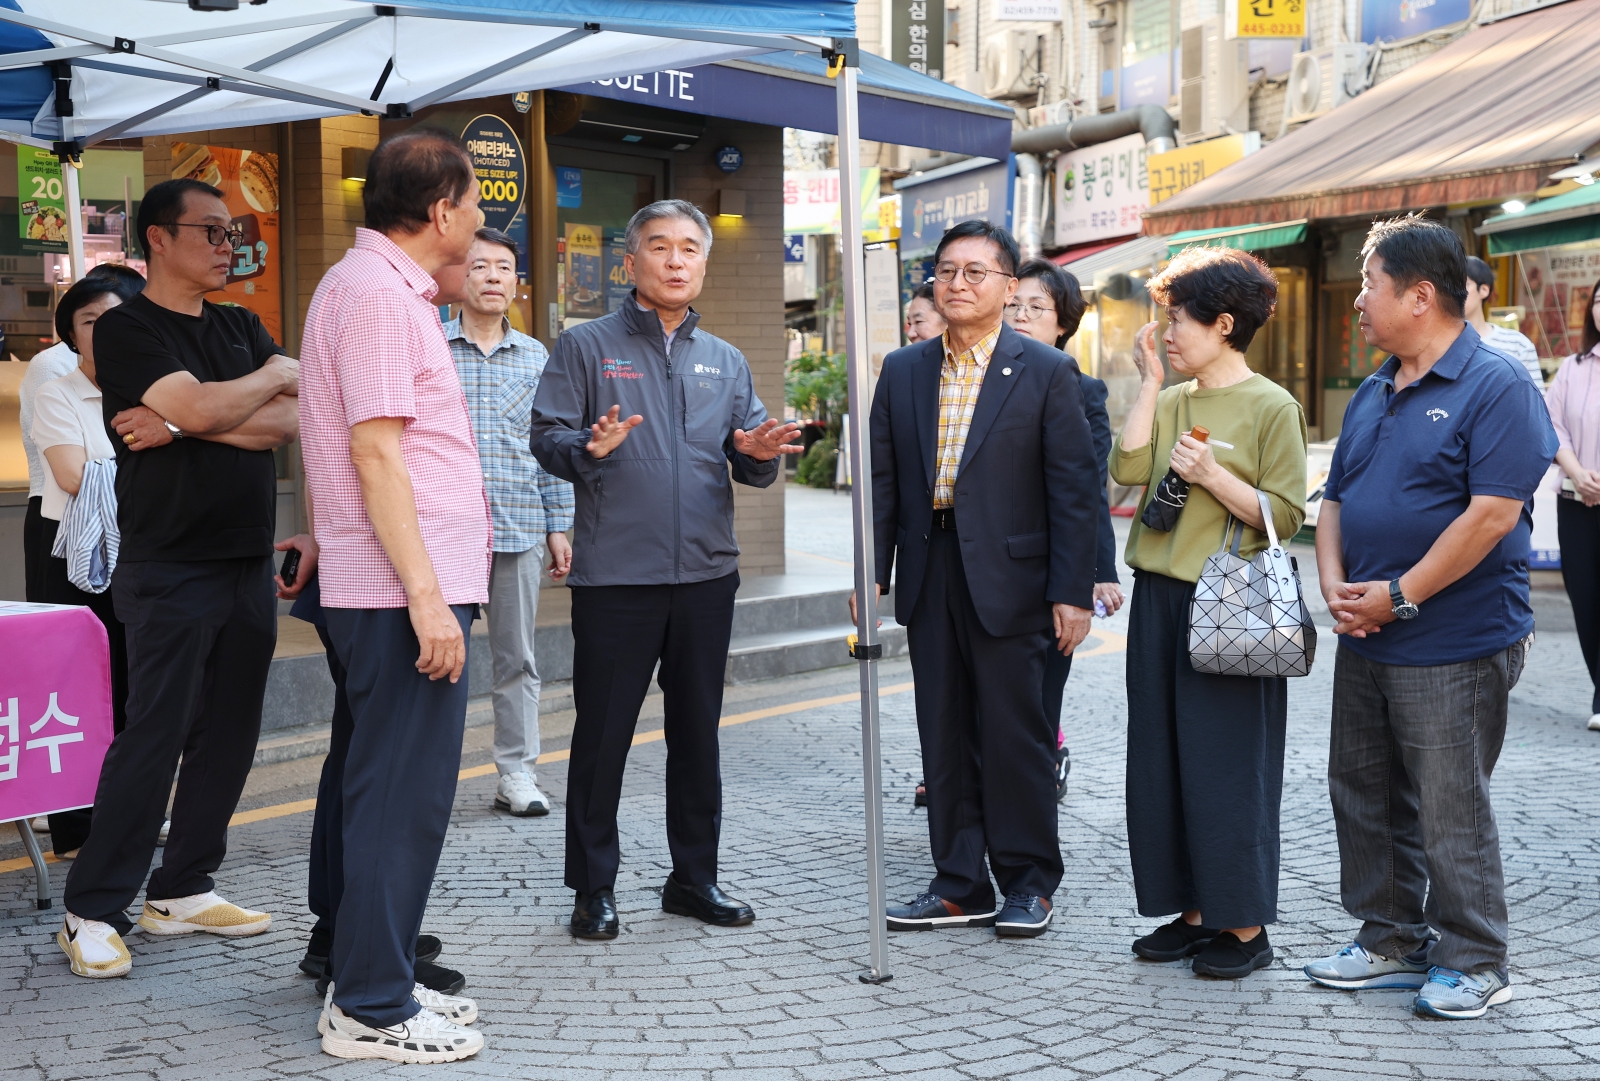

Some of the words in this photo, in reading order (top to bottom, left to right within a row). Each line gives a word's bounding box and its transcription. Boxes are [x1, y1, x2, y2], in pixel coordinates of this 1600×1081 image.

[1242, 23, 1302, 35] 445-0233
[467, 139, 517, 158] 아메리카노
[474, 157, 511, 168] (HOT/ICED)
[720, 152, 740, 165] ADT
[489, 169, 505, 179] SIZE
[505, 171, 519, 179] UP!
[31, 176, 64, 200] 20
[1426, 407, 1449, 419] Callaway
